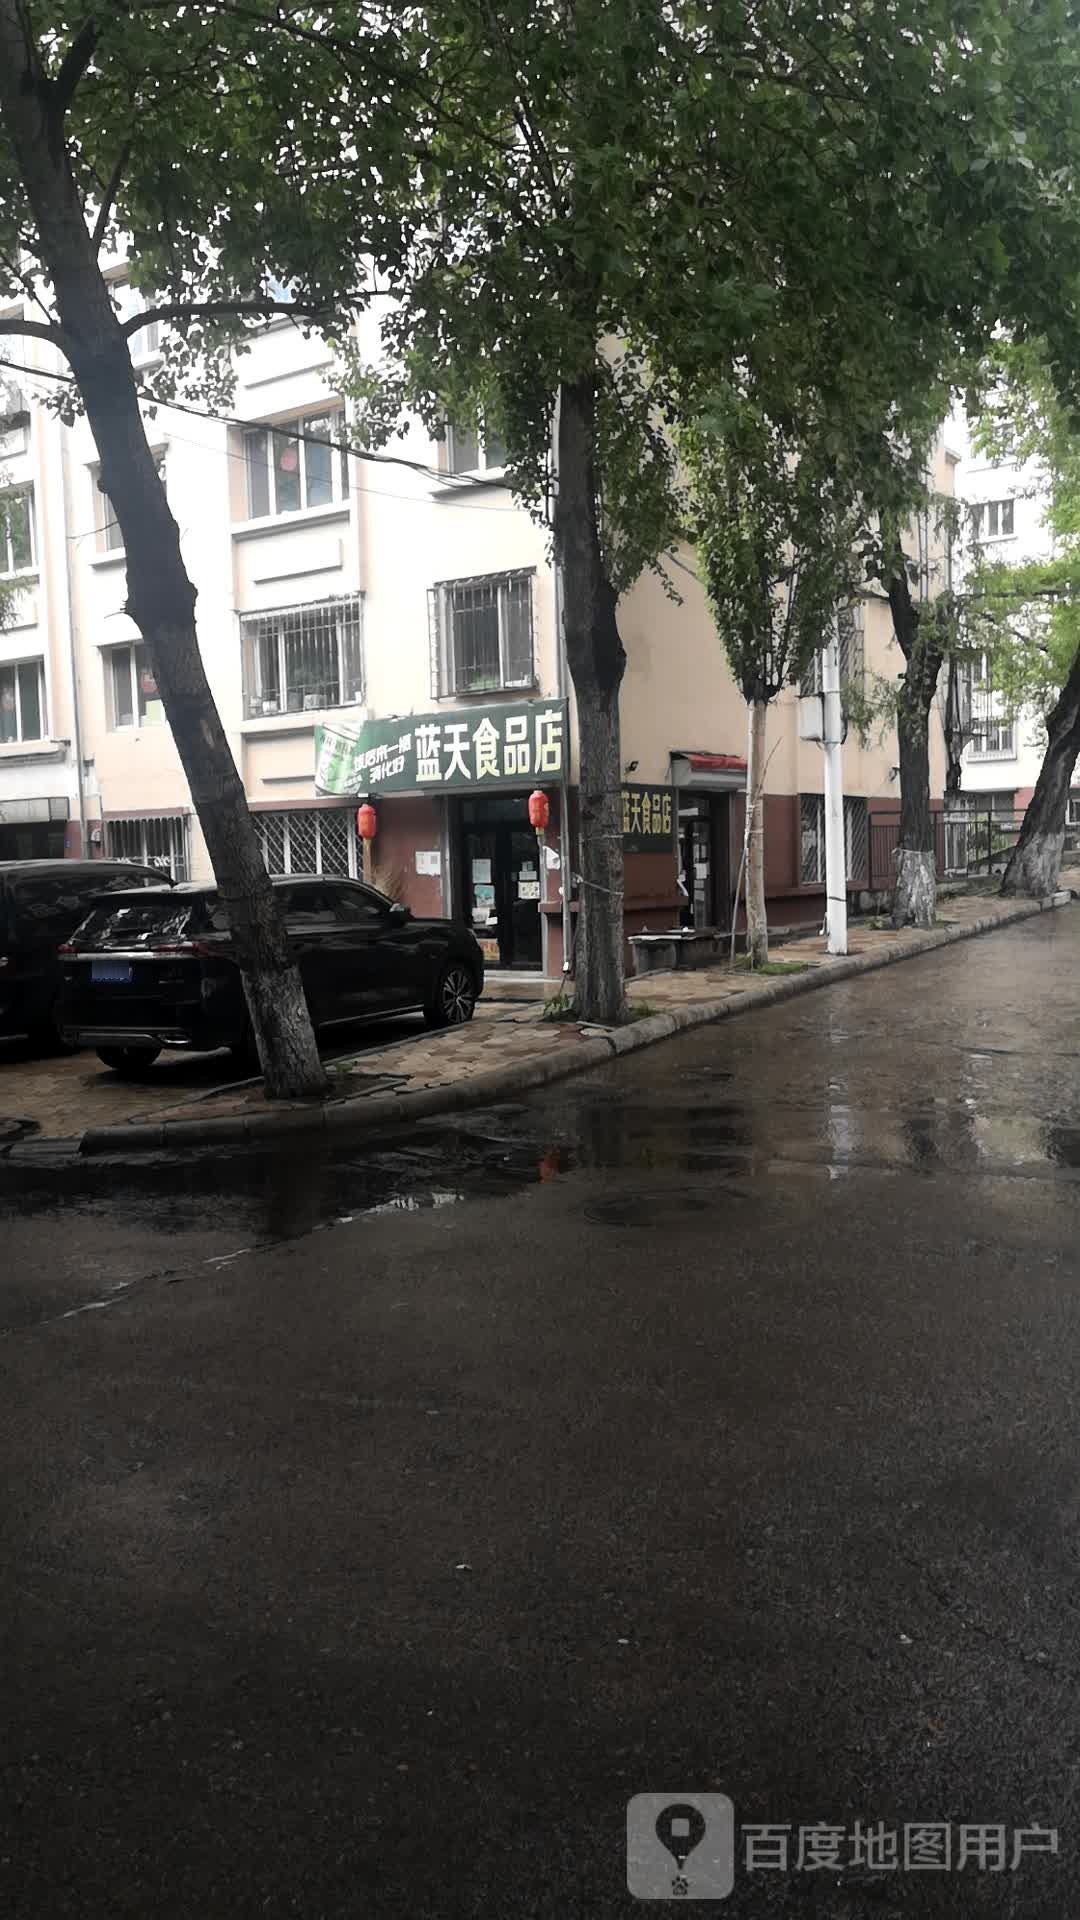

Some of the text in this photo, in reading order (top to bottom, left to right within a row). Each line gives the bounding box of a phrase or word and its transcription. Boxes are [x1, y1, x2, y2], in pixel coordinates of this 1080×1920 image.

[415, 709, 562, 782] 蓝天食品店
